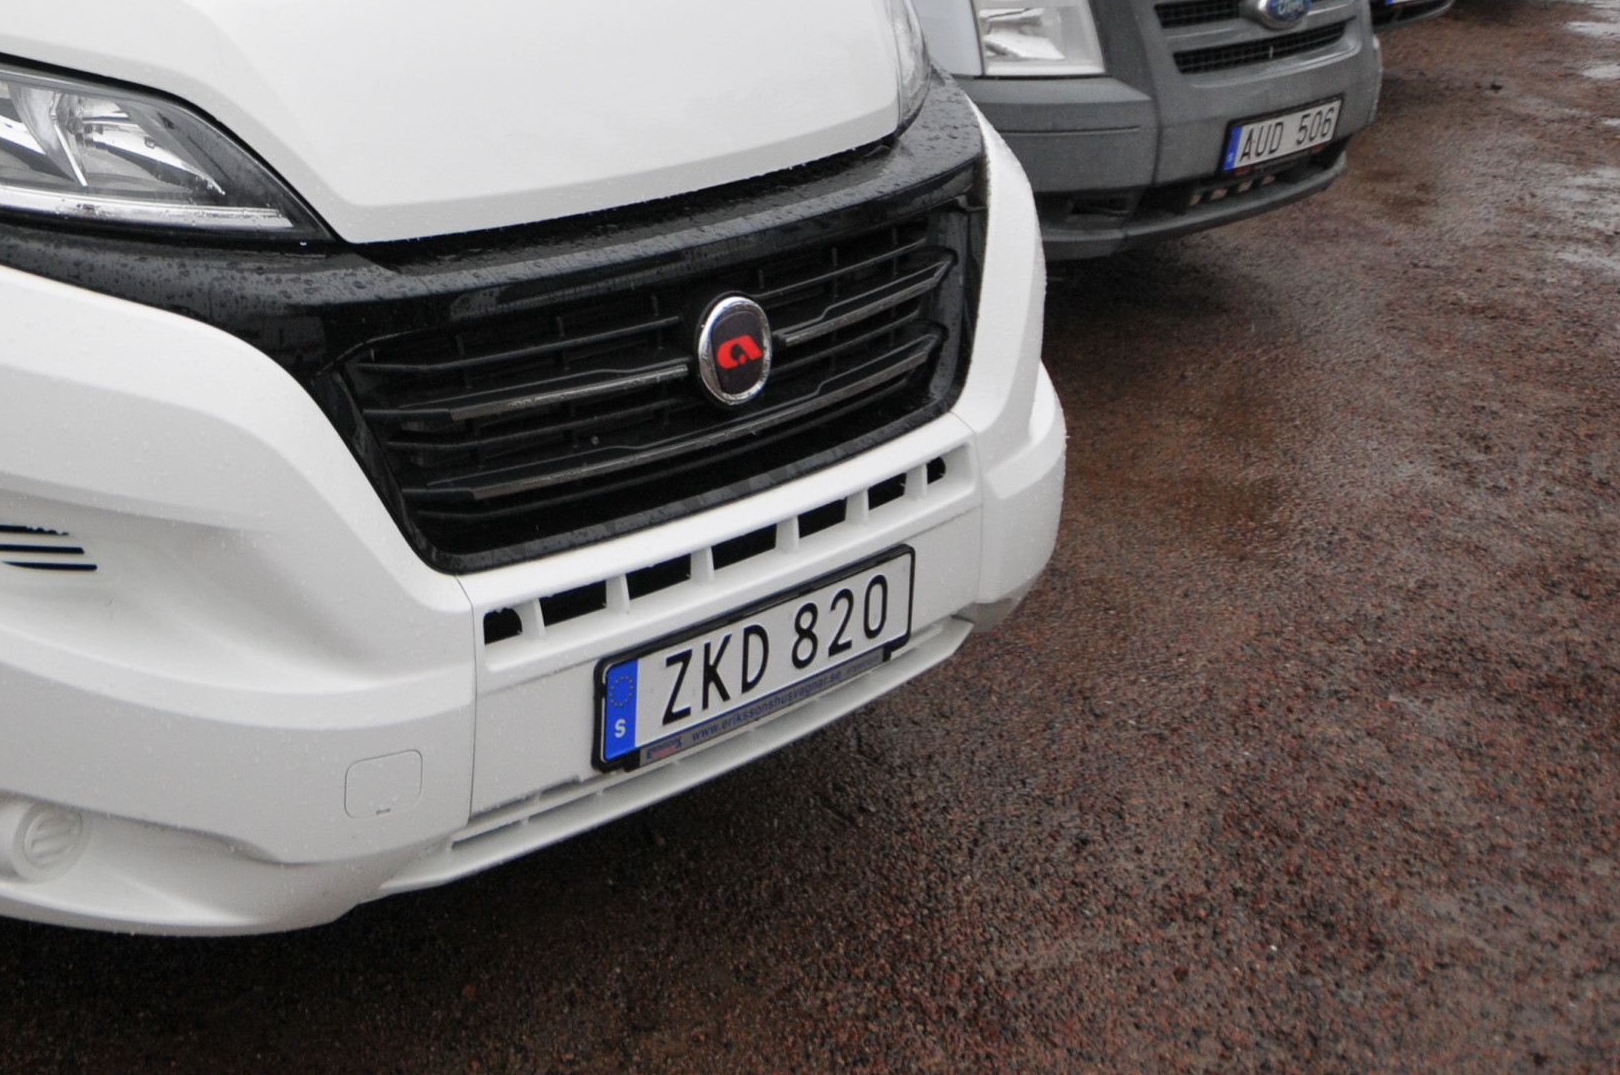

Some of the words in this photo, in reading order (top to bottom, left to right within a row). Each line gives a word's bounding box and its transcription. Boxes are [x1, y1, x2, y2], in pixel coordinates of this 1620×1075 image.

[1239, 121, 1284, 163] AUD
[1295, 106, 1335, 145] 506
[661, 623, 770, 726] ZKD
[791, 574, 888, 670] 820
[614, 718, 626, 738] S
[691, 670, 841, 742] www.erikssonshusvagnar.se
